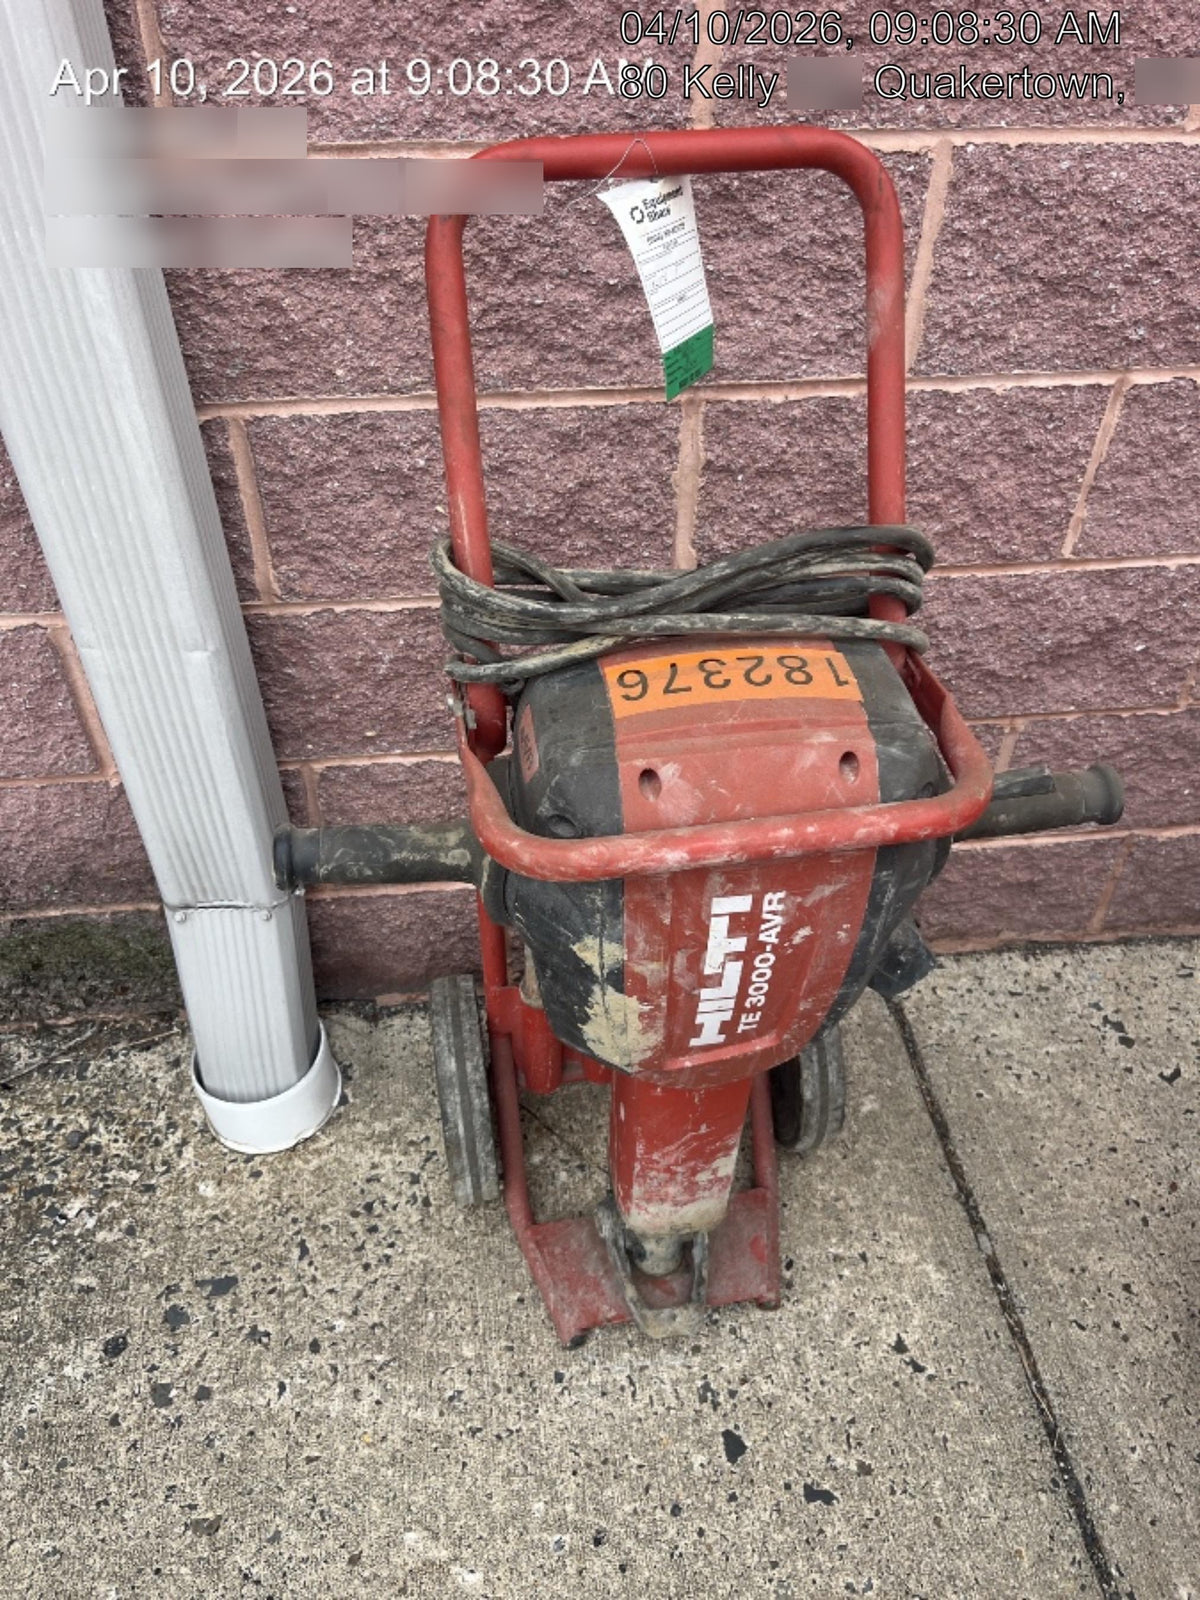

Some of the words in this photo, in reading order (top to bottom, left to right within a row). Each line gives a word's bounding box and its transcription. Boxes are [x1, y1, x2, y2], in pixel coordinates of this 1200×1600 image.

[616, 655, 849, 702] 182376
[688, 894, 753, 1047] HILTI
[744, 890, 787, 1007] 3000-AVR
[737, 1012, 762, 1034] TE
